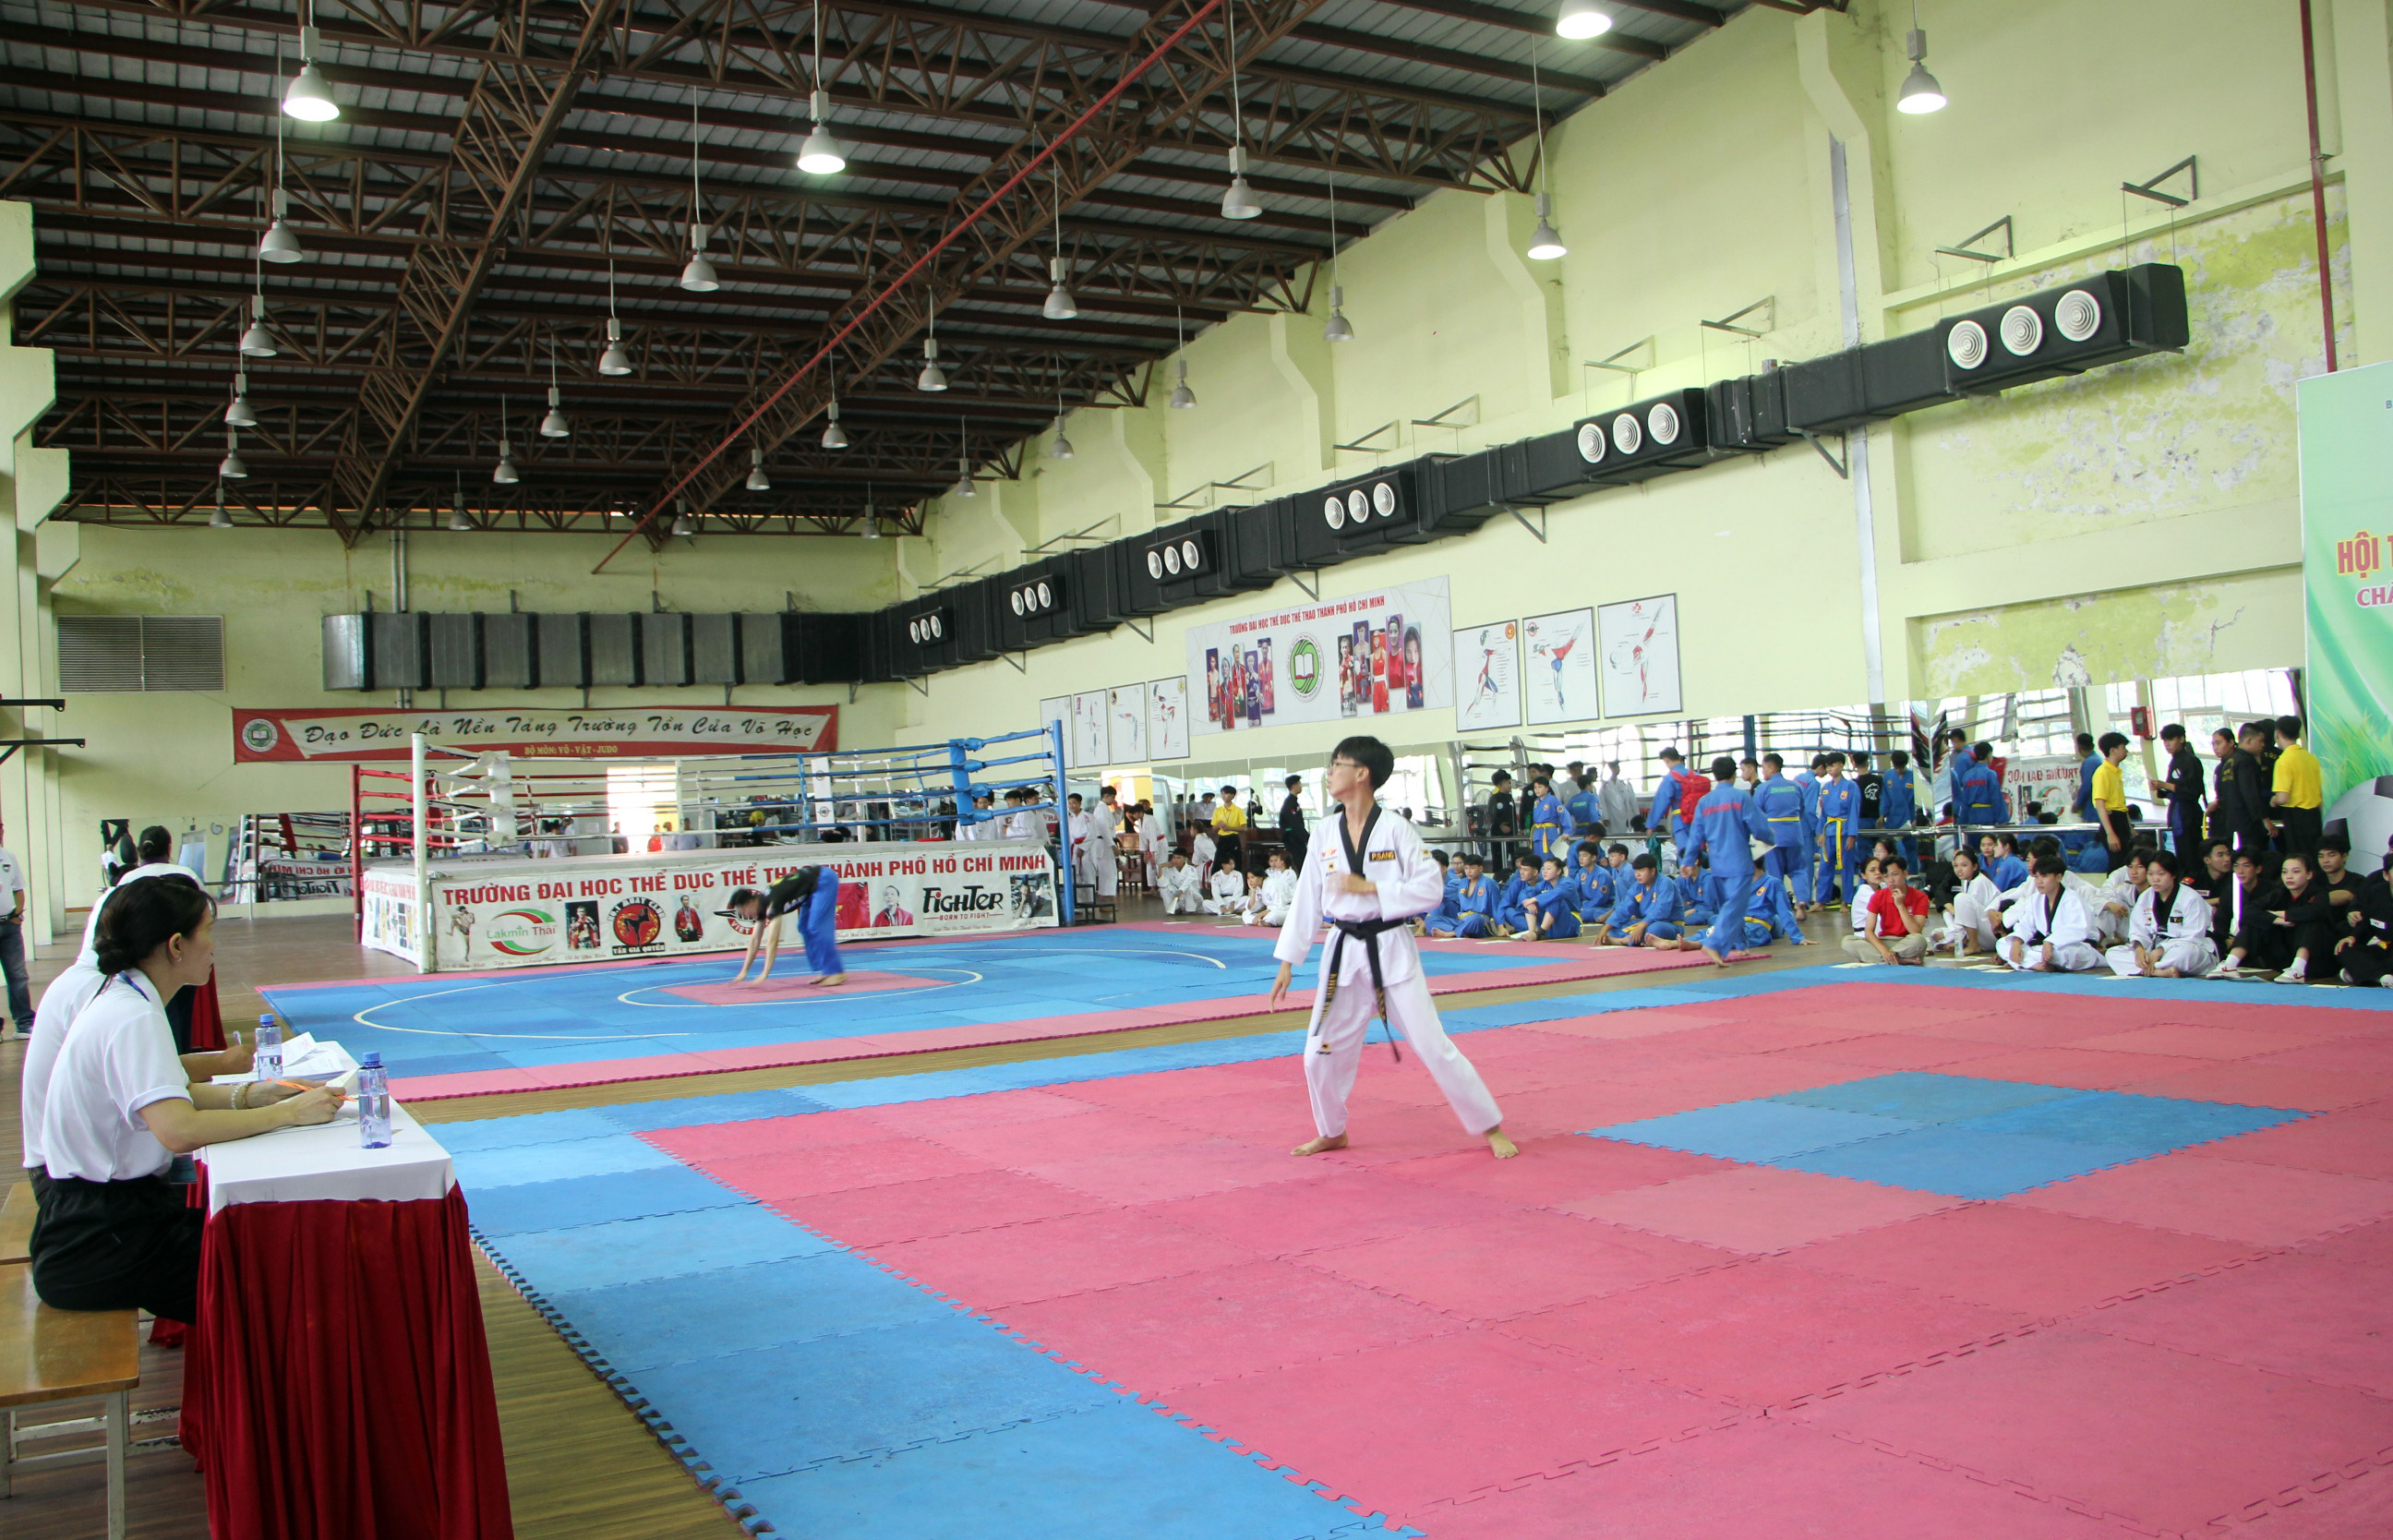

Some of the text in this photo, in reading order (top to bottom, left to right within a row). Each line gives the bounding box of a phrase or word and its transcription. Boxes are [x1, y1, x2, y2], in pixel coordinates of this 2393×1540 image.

[2337, 531, 2380, 578] HỘI
[1258, 618, 1269, 631] HỌC
[1280, 614, 1291, 626] DỤC
[1302, 609, 1316, 621] THAO
[1317, 605, 1335, 619] THÀNH
[1369, 596, 1385, 608] MINH
[305, 715, 812, 746] Đạo Đức Là Nền Tảng Trường Tồn Của Võ Học
[596, 745, 619, 753] JUDO
[443, 883, 530, 906] TRƯỜNG
[537, 881, 573, 902] ĐẠI
[581, 878, 622, 899] HỌC
[629, 869, 667, 893] THỂ
[674, 872, 715, 893] DỤC
[721, 862, 763, 886] THỂ
[889, 854, 926, 875] PHỐ
[932, 853, 956, 873] HỒ
[963, 853, 992, 872] CHÍ
[1000, 854, 1045, 871] MINH
[487, 925, 557, 939] Lakmin Thai
